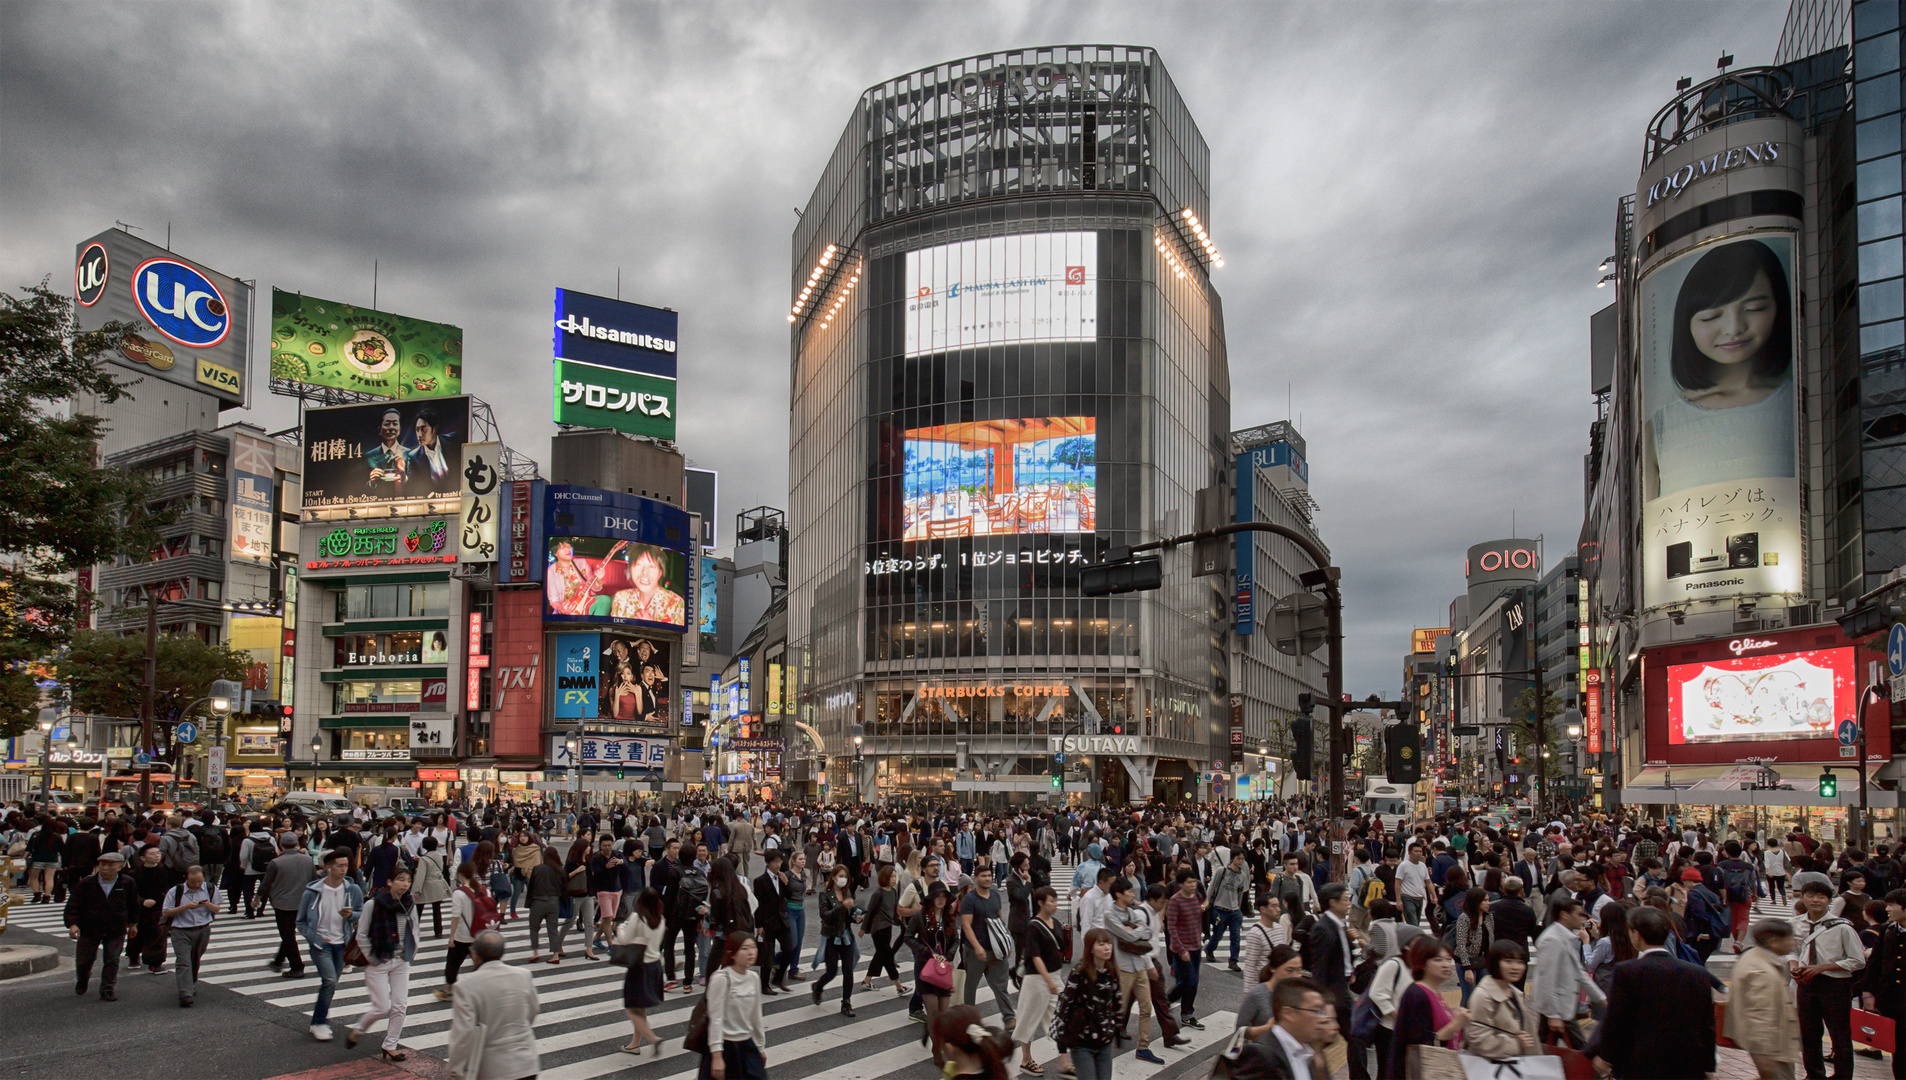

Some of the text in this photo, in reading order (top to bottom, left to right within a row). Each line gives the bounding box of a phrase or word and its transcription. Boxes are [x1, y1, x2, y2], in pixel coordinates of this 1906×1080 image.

[79, 257, 106, 292] UC
[147, 271, 223, 331] UC
[556, 314, 676, 352] Hisamitsu
[202, 367, 239, 388] VISA
[350, 374, 389, 387] STRIKE
[561, 379, 671, 419] サロンパス
[311, 438, 363, 462] 相棒14
[554, 492, 603, 501] DHC Channel
[1659, 488, 1776, 518] ハイレゾは、
[463, 454, 496, 559] もんじゃ
[235, 507, 270, 525] 夜11時
[604, 516, 639, 531] DHC
[1655, 507, 1783, 538] パナソニック。
[241, 522, 264, 535] まで
[510, 484, 528, 576] 三千里薬品
[251, 539, 270, 552] 地下
[353, 535, 397, 555] 西村
[688, 534, 698, 582] Taisei
[1685, 577, 1745, 591] Panasonic
[1506, 601, 1524, 631] ZAR
[583, 646, 590, 659] 2
[1729, 638, 1778, 655] Glico
[348, 652, 419, 665] Euphoria
[424, 681, 446, 697] JTB
[559, 676, 596, 689] DMM
[564, 690, 590, 704] FX
[918, 686, 1070, 698] STARBUCKS COFFEE
[558, 741, 664, 761] 大盛堂書店
[1052, 737, 1138, 753] TSUTAYA
